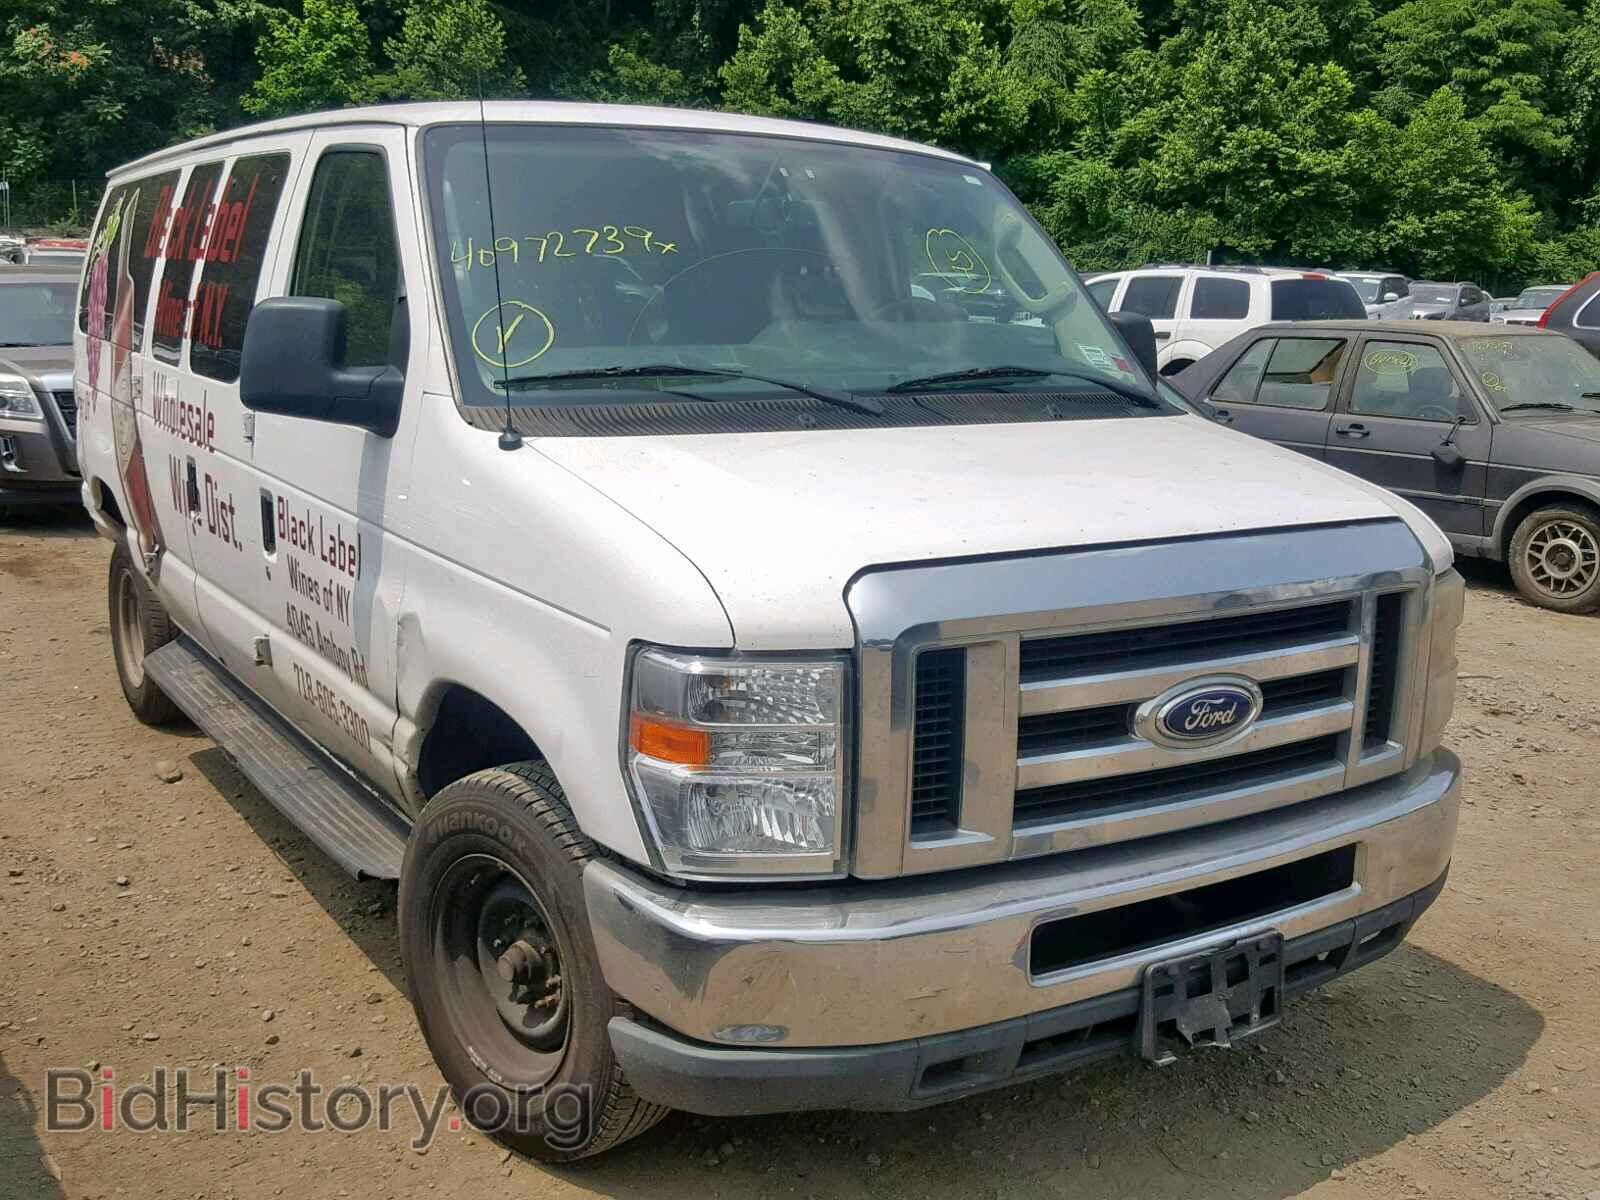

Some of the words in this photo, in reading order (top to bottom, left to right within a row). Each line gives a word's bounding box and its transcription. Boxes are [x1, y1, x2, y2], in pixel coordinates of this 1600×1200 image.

[153, 371, 215, 455] Wholesale
[169, 454, 202, 527] Wi
[205, 472, 243, 552] Dist.
[277, 496, 315, 556] Black
[320, 515, 361, 581] Label
[286, 553, 321, 605] Wines
[323, 579, 334, 615] of
[336, 583, 351, 627] NY
[286, 602, 316, 650] 4045
[351, 646, 370, 690] Rd
[1185, 698, 1238, 730] Ford
